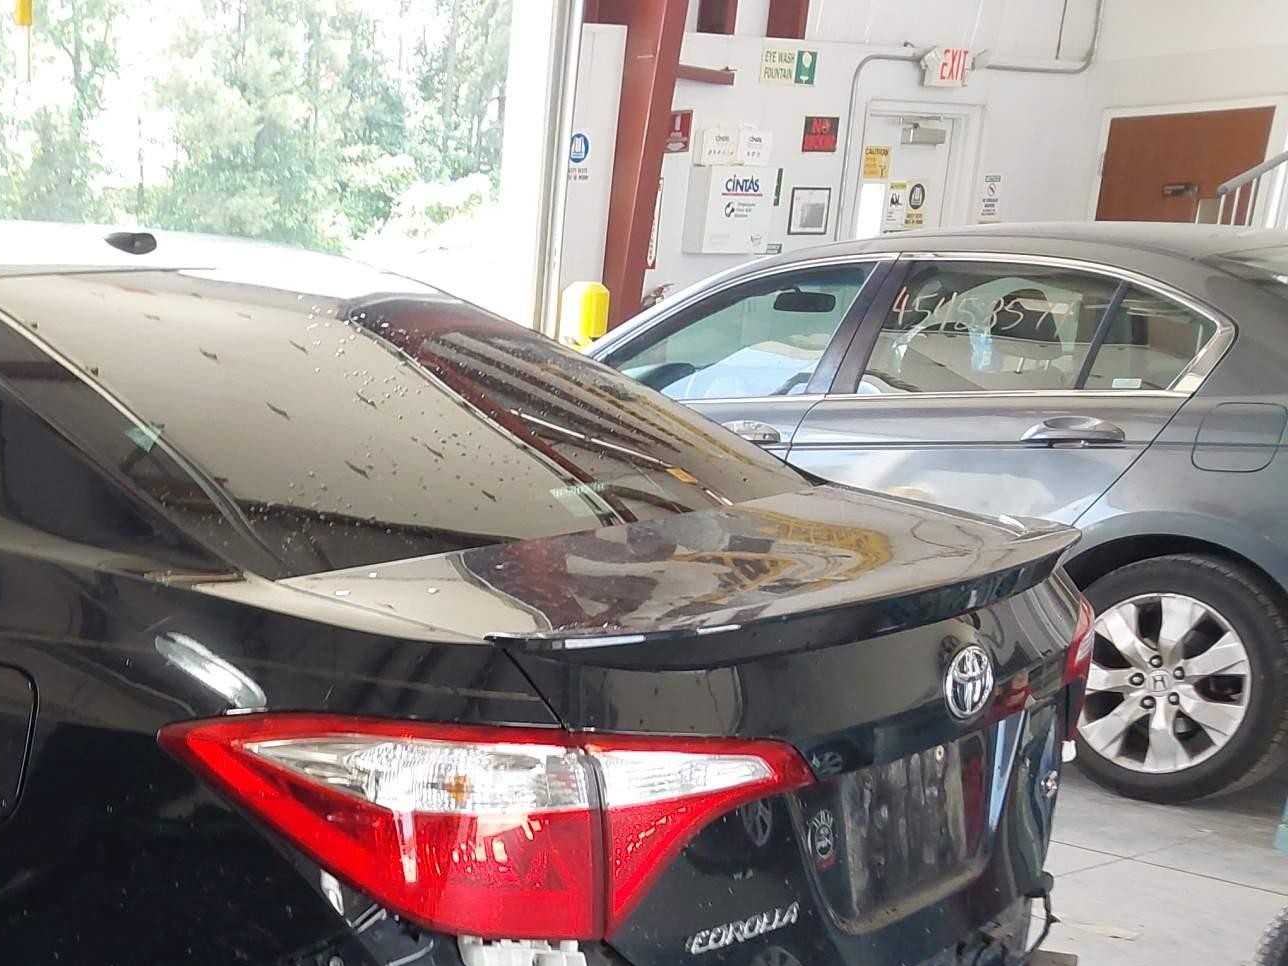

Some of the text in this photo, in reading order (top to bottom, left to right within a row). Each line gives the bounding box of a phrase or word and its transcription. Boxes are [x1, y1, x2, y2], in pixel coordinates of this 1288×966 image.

[765, 50, 795, 64] EYE WASH
[940, 48, 969, 80] EXIT
[763, 66, 793, 79] FOUNTAIN
[725, 174, 761, 193] CINTAS
[690, 901, 799, 954] COROLLA
